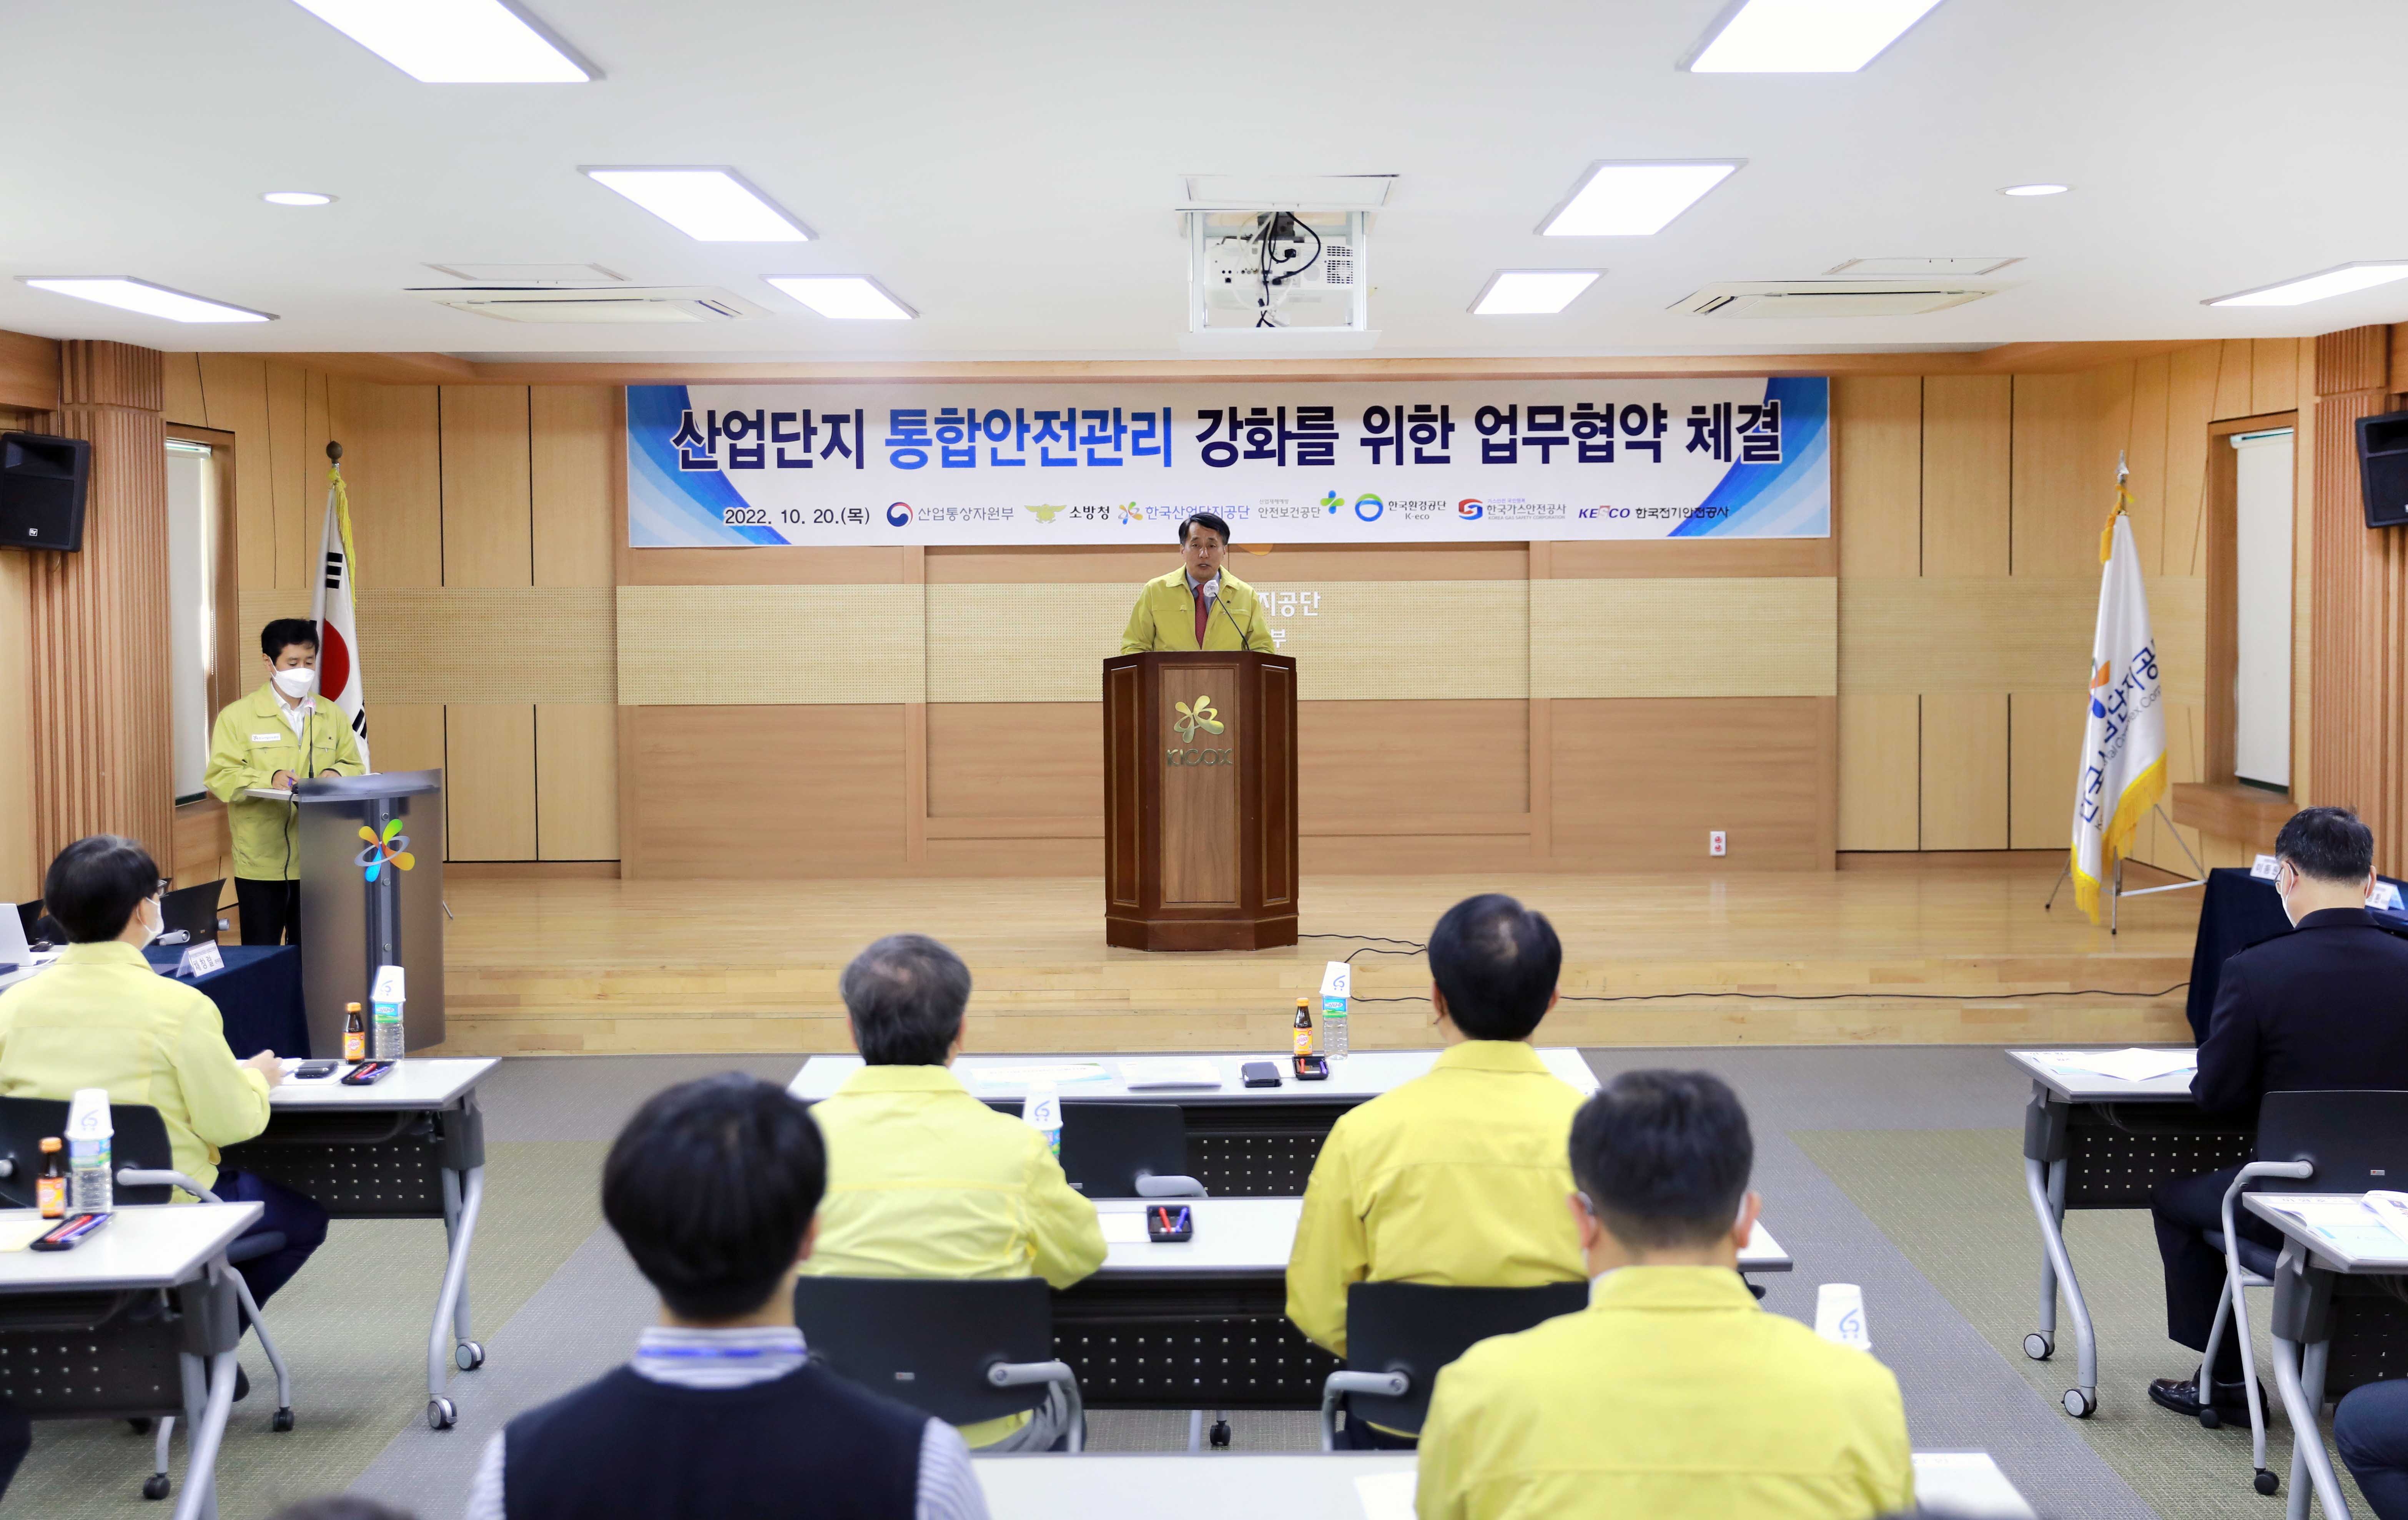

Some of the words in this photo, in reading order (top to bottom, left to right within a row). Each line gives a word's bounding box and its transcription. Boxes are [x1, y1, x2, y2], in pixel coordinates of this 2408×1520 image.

[672, 409, 864, 469] 산업단지
[885, 406, 1172, 470] 통합안전관리
[1195, 406, 1339, 468] 강화를
[1360, 404, 1455, 466] 위한
[1474, 402, 1668, 464] 업무협약
[1686, 401, 1780, 462] 체결
[1388, 501, 1447, 511] 한국환경공단
[1487, 504, 1567, 515] 한국가스안전공사
[1635, 506, 1729, 519] 한국전기안전공사
[725, 509, 772, 524] 2022.
[781, 509, 805, 524] 10.
[813, 507, 870, 525] 20.(목)
[918, 507, 1014, 521] 산업통상자원부
[1069, 506, 1109, 520] 소방청
[1258, 507, 1320, 519] 안전보건공단
